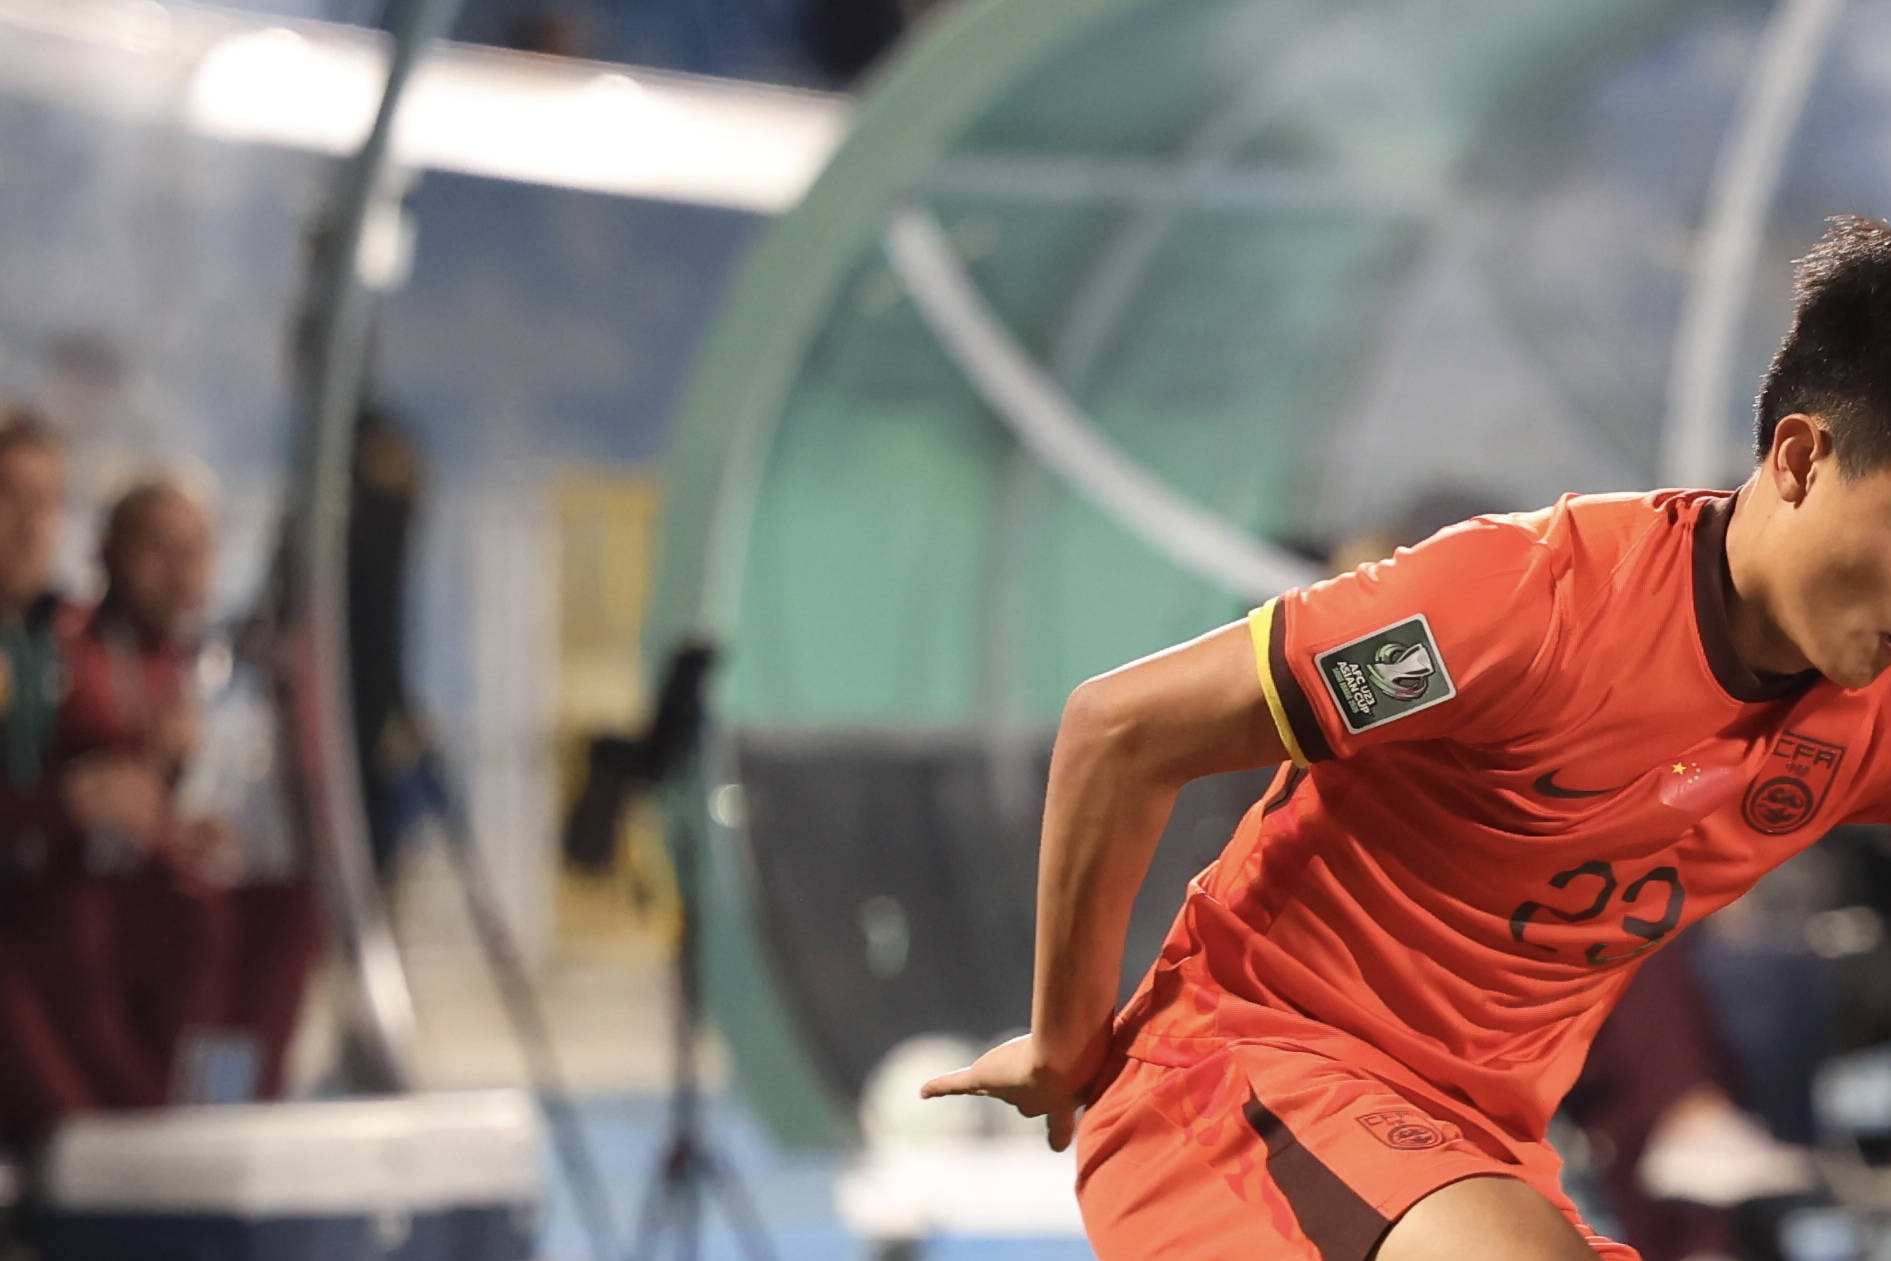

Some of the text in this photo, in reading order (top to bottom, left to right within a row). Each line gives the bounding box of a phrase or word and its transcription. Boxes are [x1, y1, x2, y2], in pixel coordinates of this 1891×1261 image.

[1337, 661, 1360, 693] ASIAN
[1354, 692, 1370, 714] CUP
[1349, 664, 1376, 706] AFC U23
[1773, 738, 1836, 769] CFA
